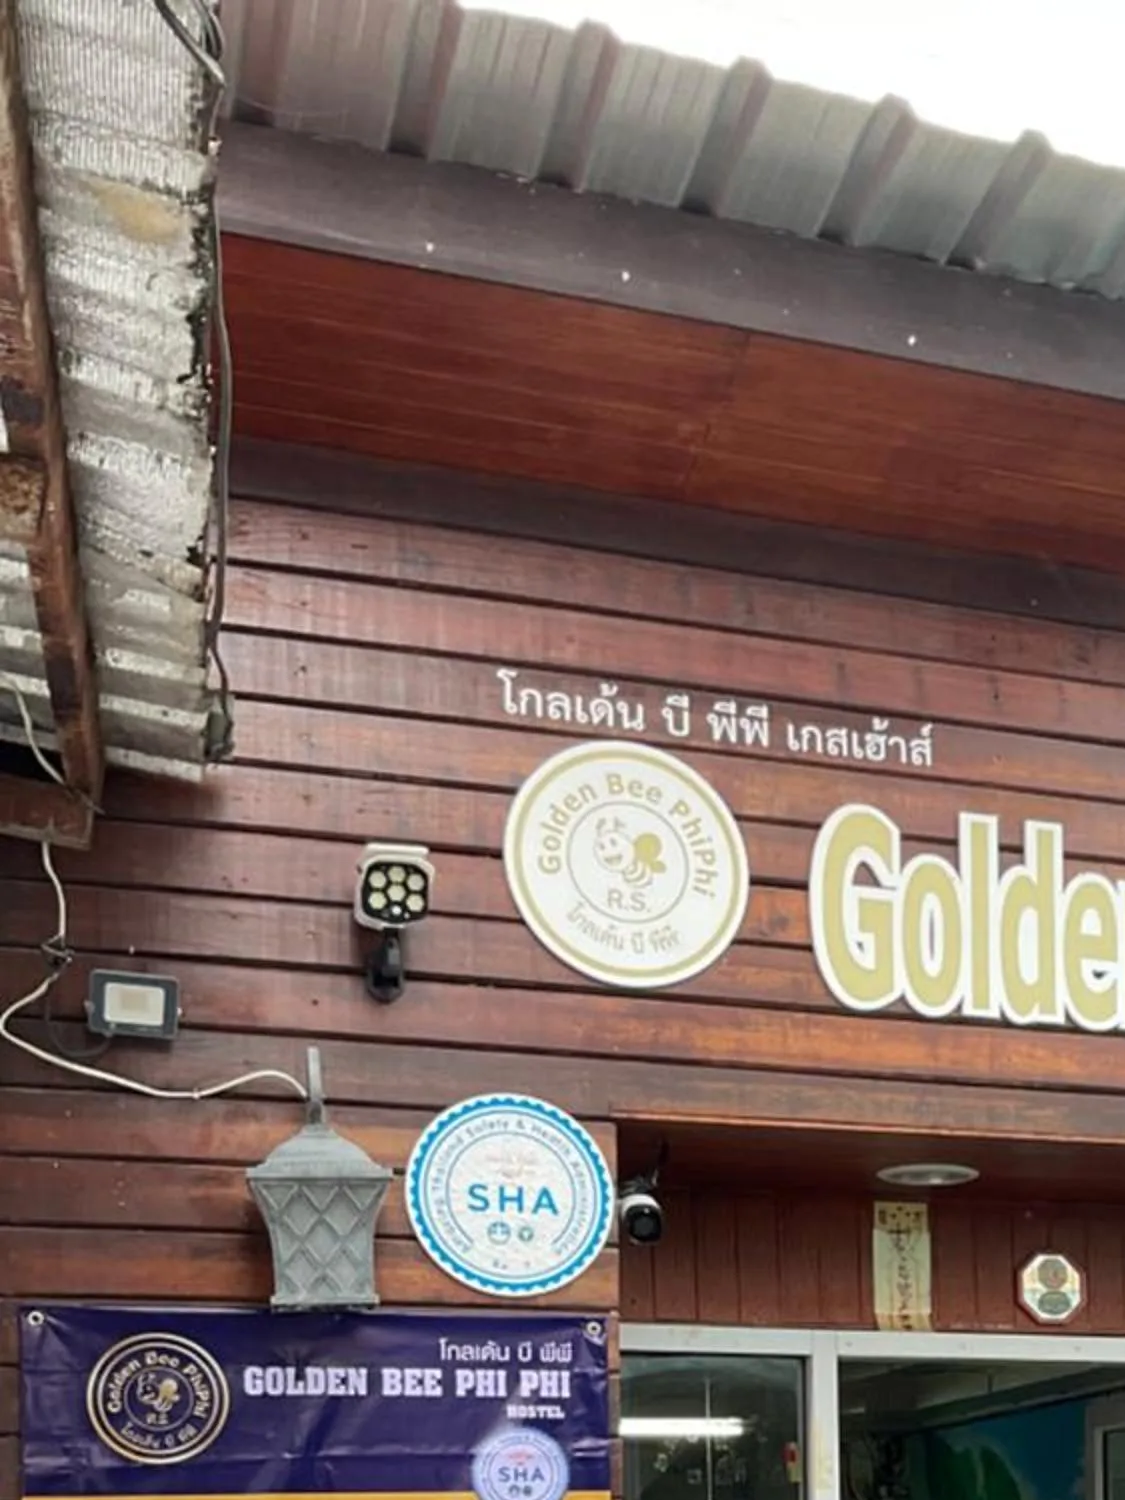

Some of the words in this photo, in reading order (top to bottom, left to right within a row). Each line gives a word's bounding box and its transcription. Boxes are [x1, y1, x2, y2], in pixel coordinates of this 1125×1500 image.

[498, 670, 645, 731] โกลเด้น
[663, 696, 690, 736] บี
[707, 700, 770, 748] พีพี
[538, 783, 598, 874] Golden
[606, 772, 663, 805] Bee
[669, 800, 719, 900] PhiPhi
[607, 888, 651, 913] R.S.
[467, 1183, 559, 1216] SHA
[243, 1366, 367, 1397] GOLDEN
[381, 1367, 443, 1397] BEE
[455, 1369, 508, 1398] PHI
[520, 1370, 571, 1399] PHI
[506, 1404, 566, 1419] HOSTEL
[498, 1467, 545, 1482] SHA
